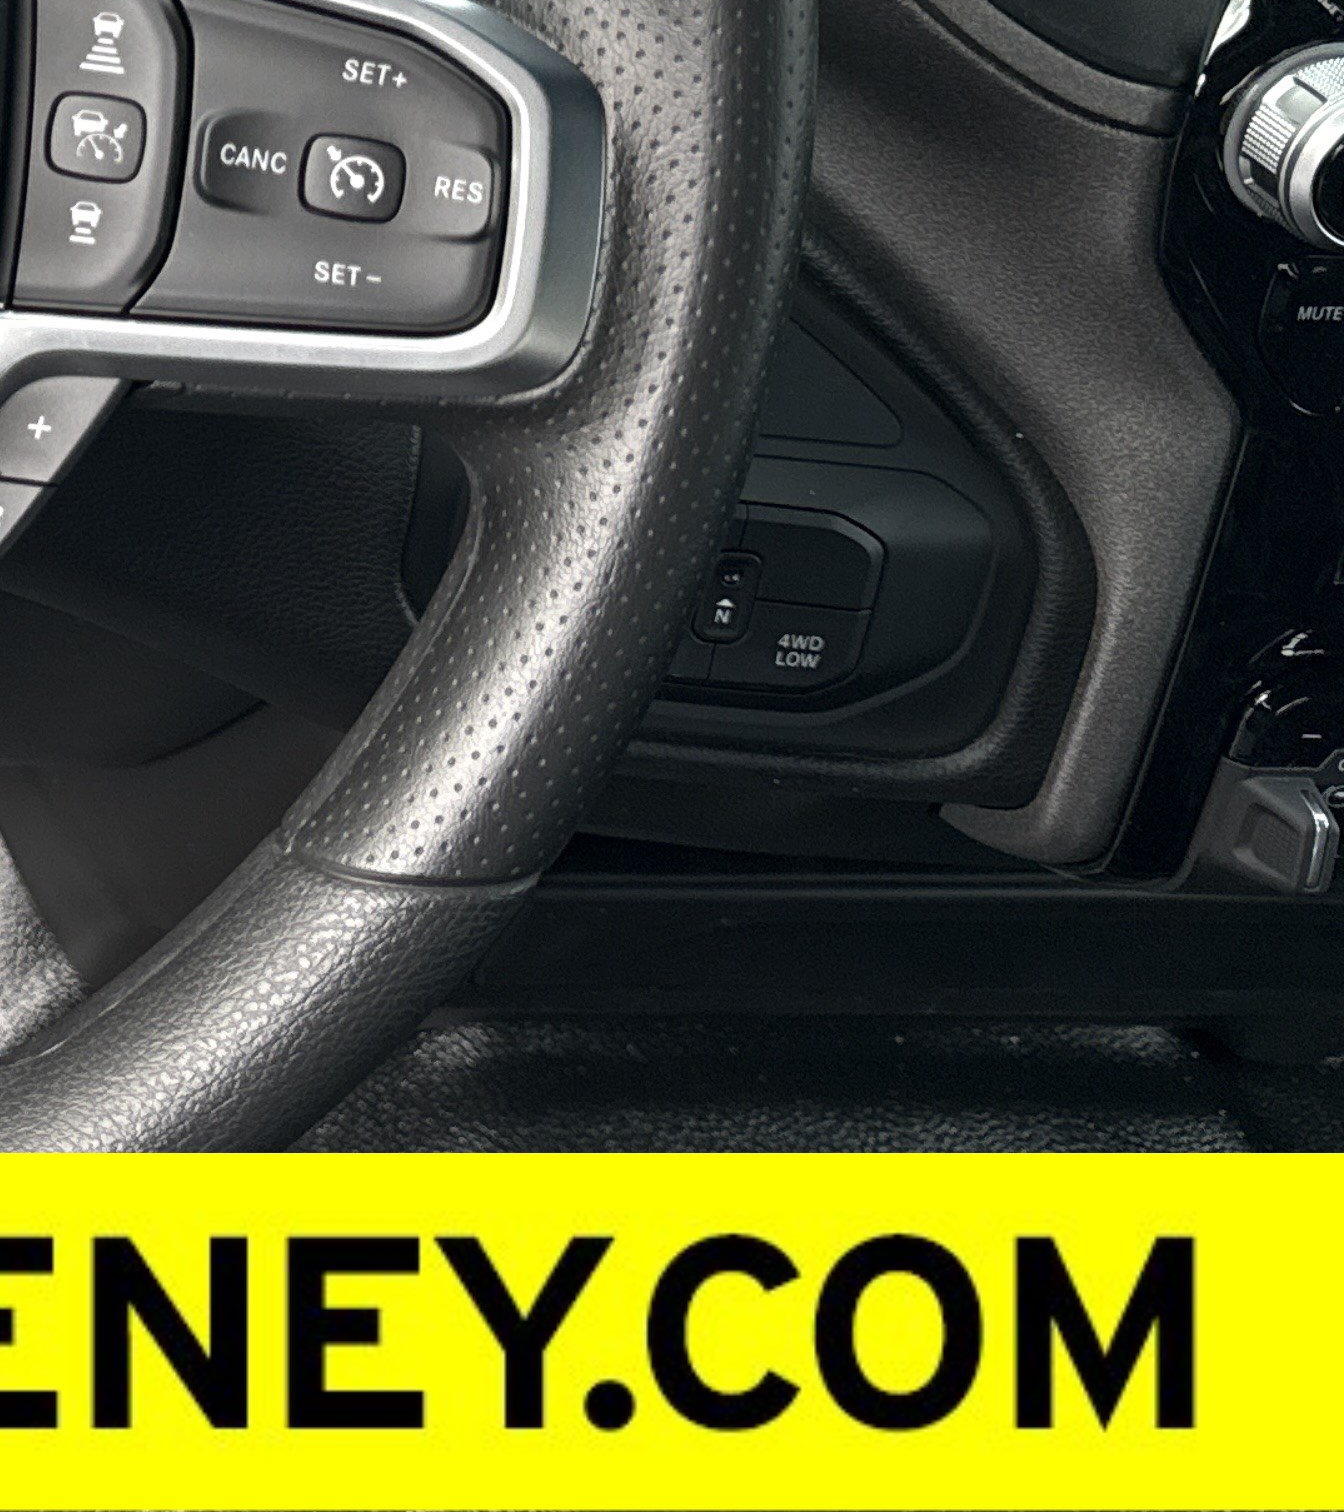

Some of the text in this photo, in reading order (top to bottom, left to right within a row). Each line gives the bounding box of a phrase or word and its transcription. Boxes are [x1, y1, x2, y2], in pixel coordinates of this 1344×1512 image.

[342, 59, 408, 90] SET+
[220, 143, 288, 175] CANC
[434, 176, 484, 204] RES
[1297, 306, 1344, 321] MUTE
[714, 609, 730, 624] N
[778, 634, 824, 651] 4WD
[775, 651, 821, 668] LOW
